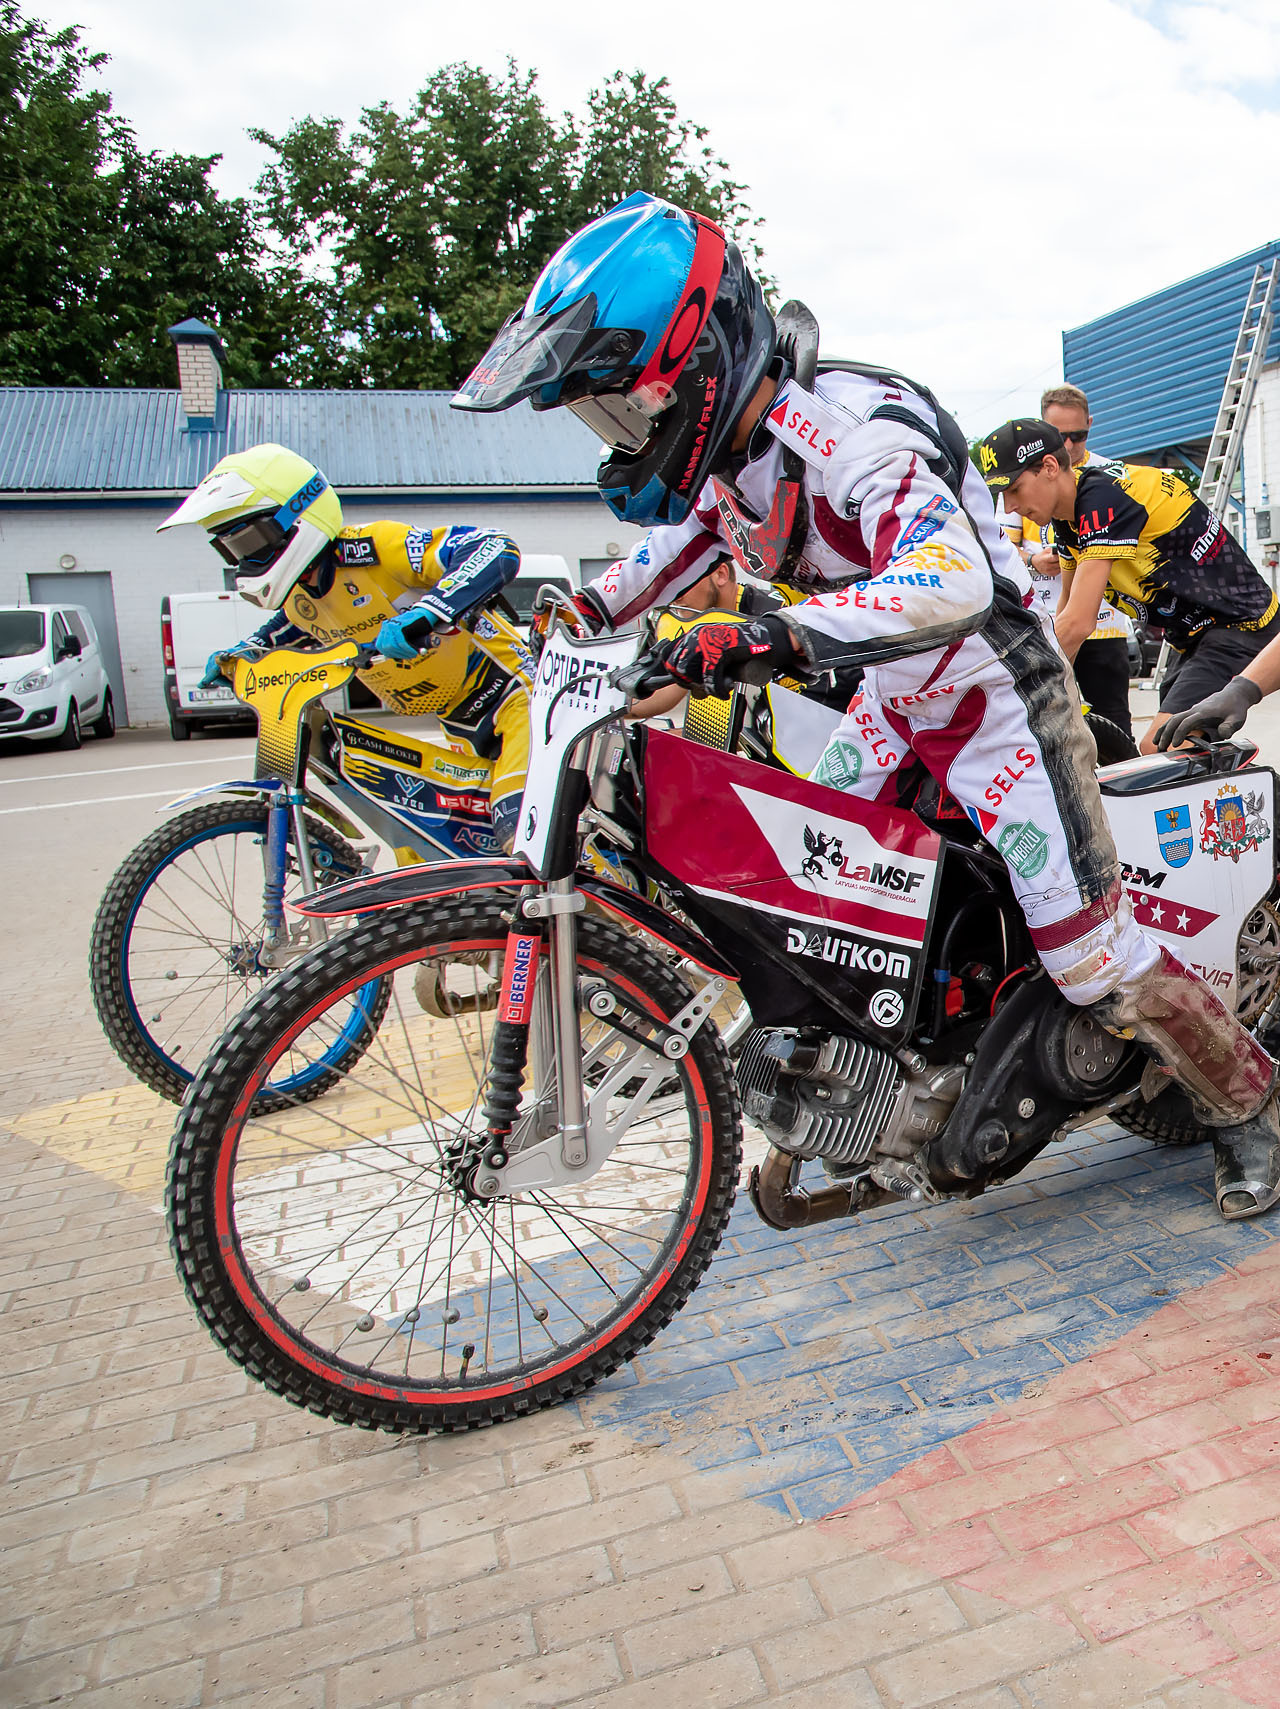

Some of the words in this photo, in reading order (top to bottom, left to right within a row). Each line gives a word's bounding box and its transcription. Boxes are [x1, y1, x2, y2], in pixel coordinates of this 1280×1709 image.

[787, 411, 837, 457] SELS
[345, 541, 371, 558] njp
[835, 590, 904, 613] SELS
[330, 612, 389, 640] spechouse
[258, 669, 328, 692] spechouse
[542, 649, 609, 700] OPTIBET
[855, 713, 898, 768] SELS
[984, 747, 1036, 808] SELS
[1006, 829, 1041, 869] IMBAŽU
[837, 855, 926, 894] LaMSF
[510, 938, 534, 1004] BERNER
